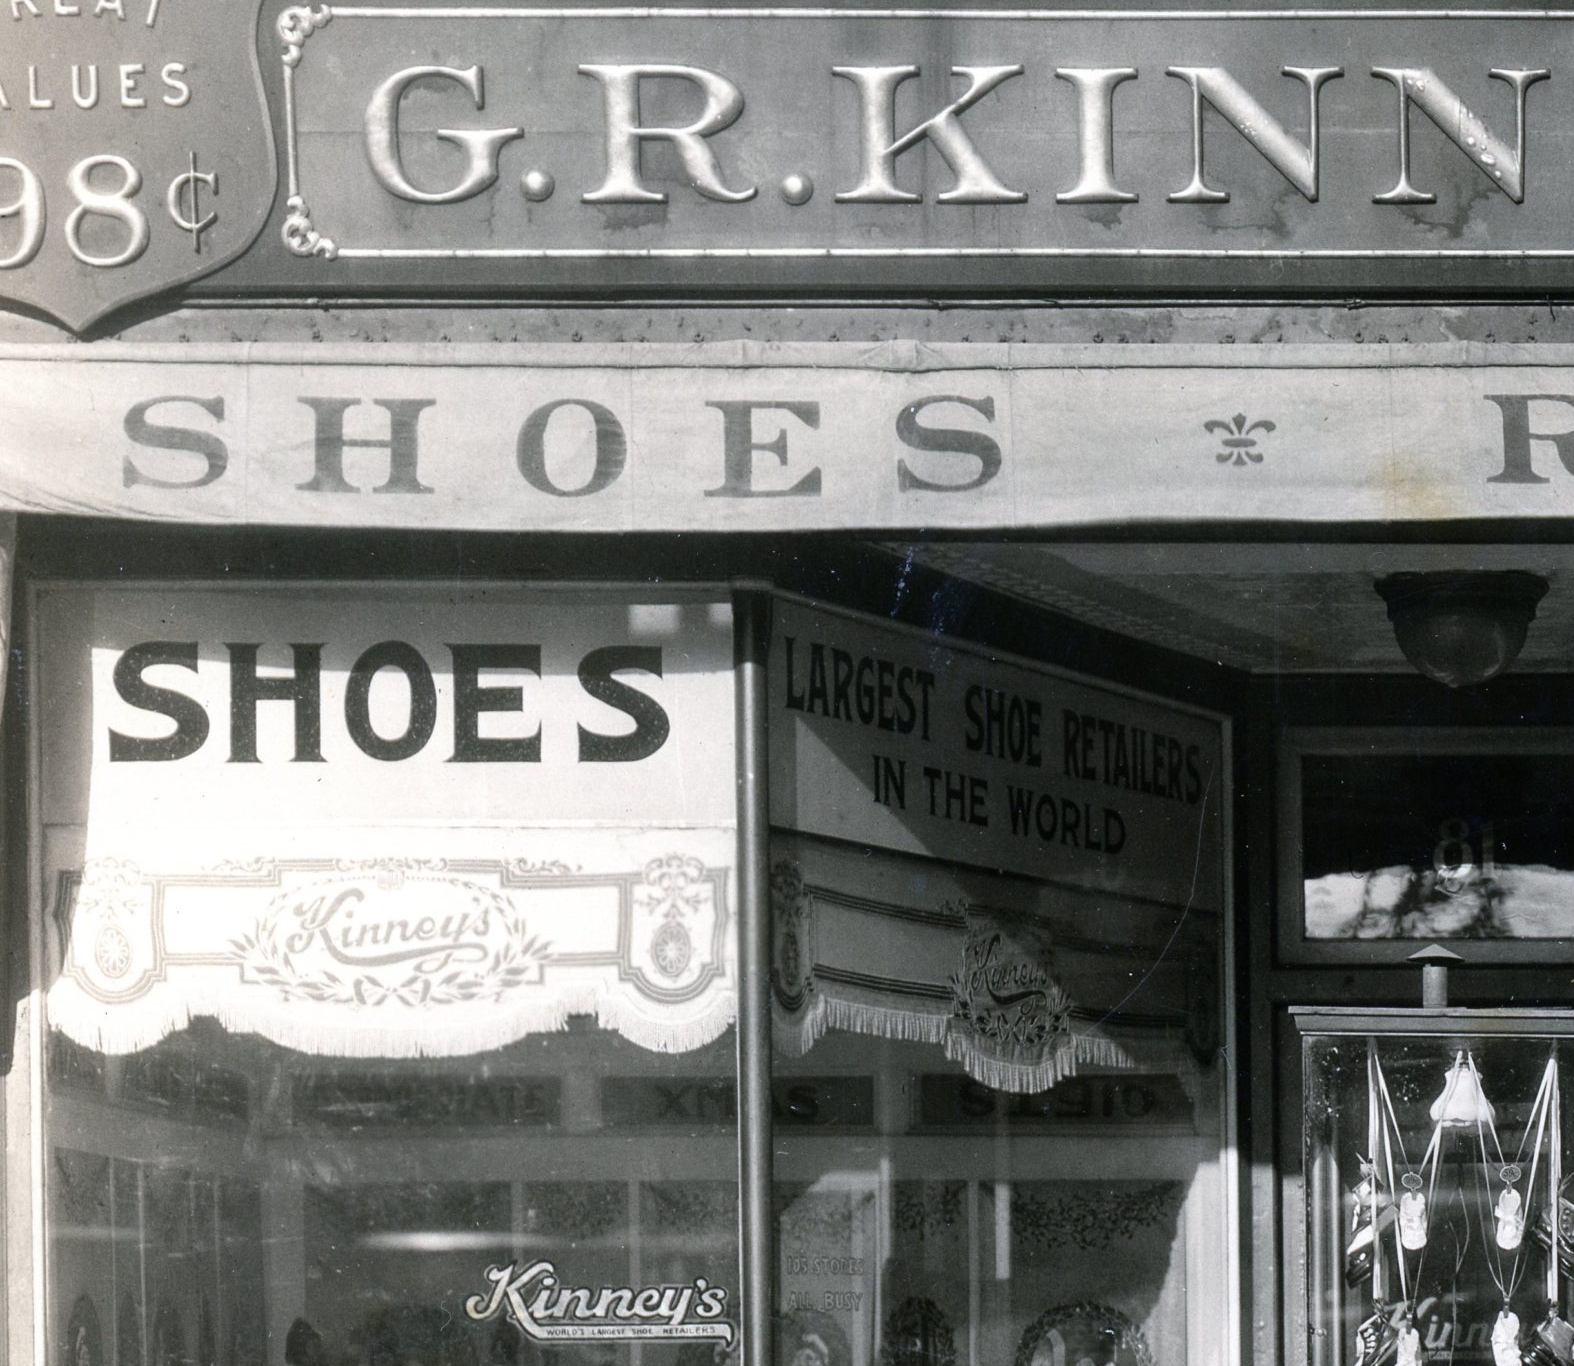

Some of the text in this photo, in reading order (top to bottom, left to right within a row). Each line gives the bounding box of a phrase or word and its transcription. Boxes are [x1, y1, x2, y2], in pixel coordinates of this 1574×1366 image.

[0, 62, 191, 109] LUES
[122, 394, 1001, 499] SHOES
[108, 640, 671, 764] SHOES
[784, 636, 1201, 805] LARGEST SHOE RETAILERS
[873, 754, 1126, 854] IN THE WORLD
[1433, 817, 1496, 879] 81
[286, 886, 492, 972] Kinney's
[465, 1259, 728, 1327] Kinney's
[814, 1256, 864, 1275] STORES
[546, 1326, 716, 1336] WORLD'S LARGEST SHOE RETAILERS
[824, 1290, 863, 1311] BUSY
